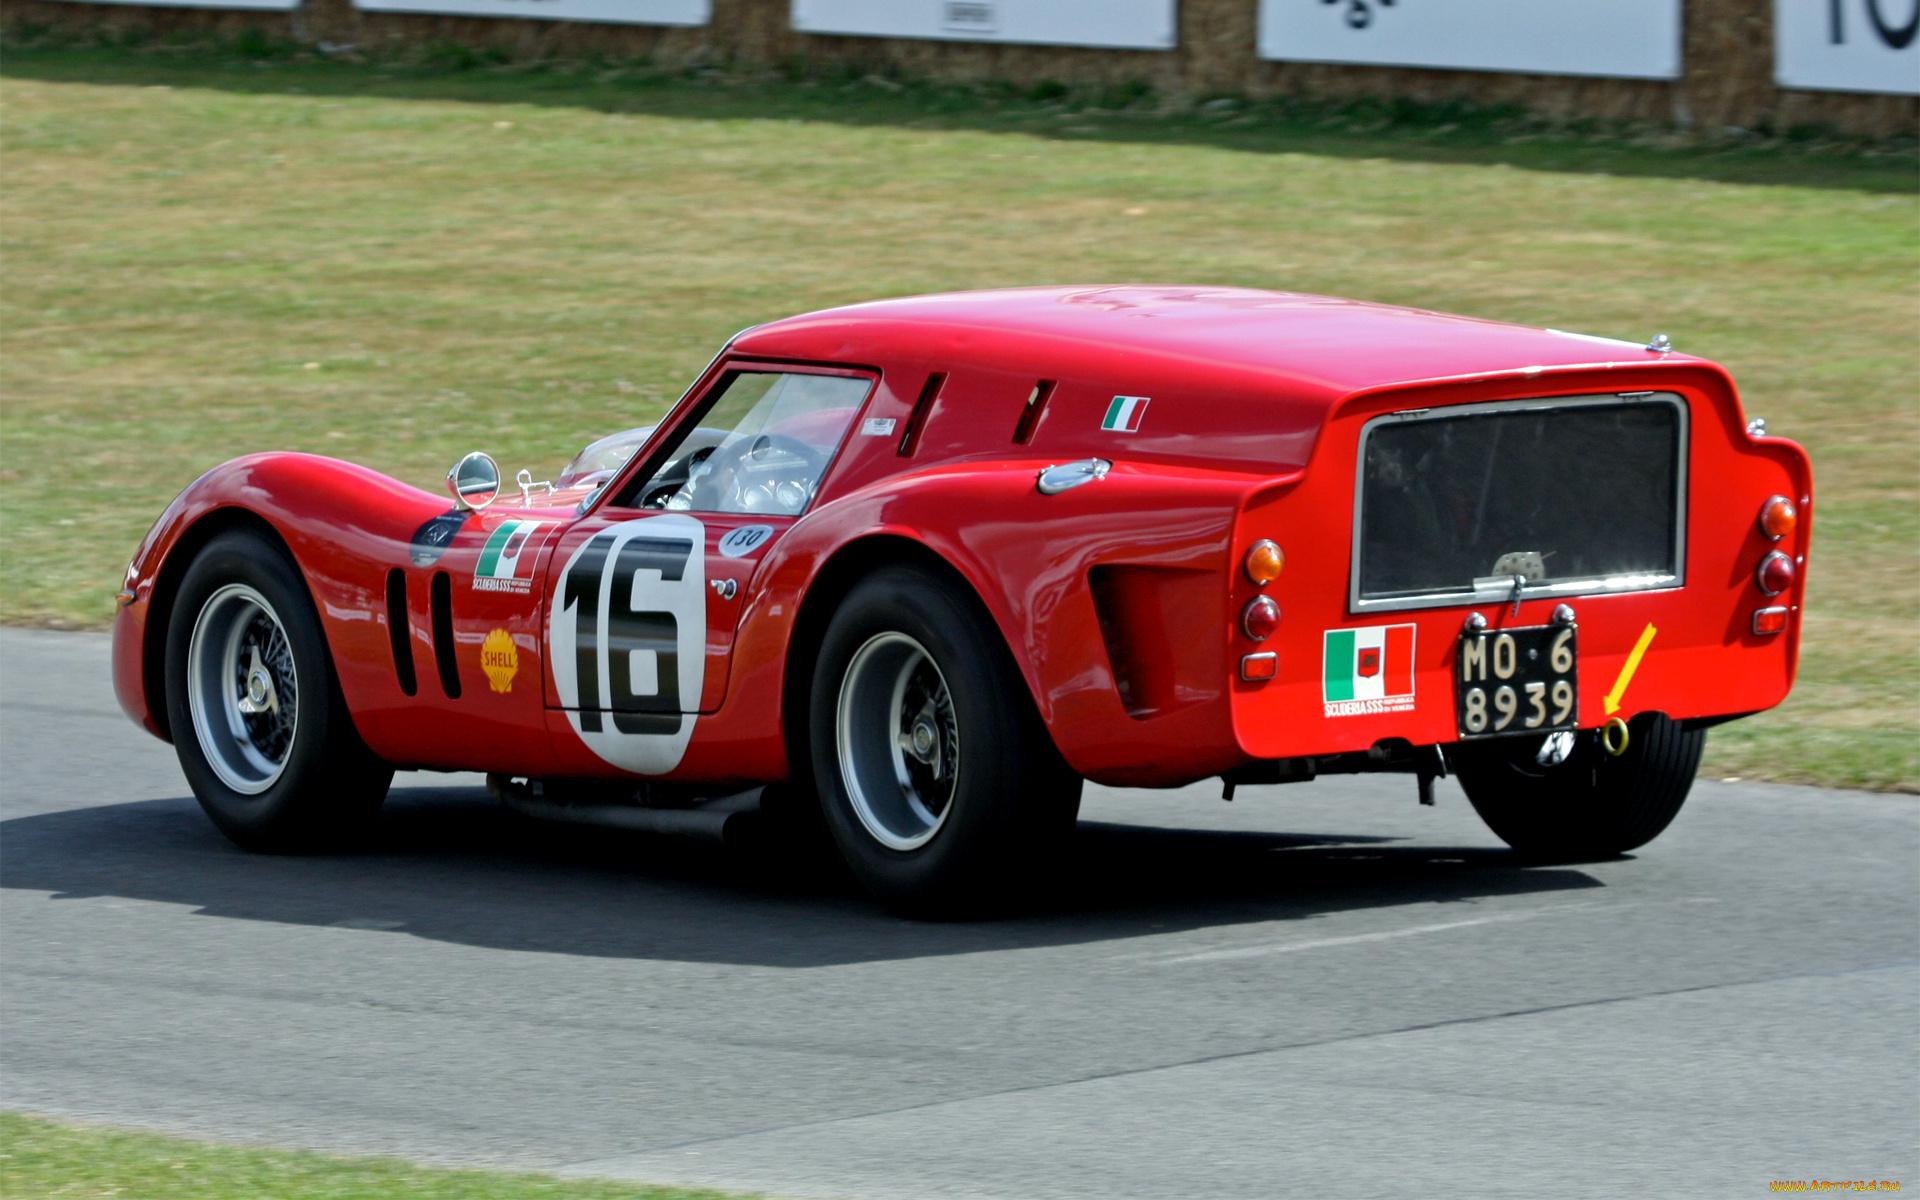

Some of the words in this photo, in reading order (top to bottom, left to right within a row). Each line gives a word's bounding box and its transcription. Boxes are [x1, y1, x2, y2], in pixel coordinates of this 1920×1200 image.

[726, 529, 764, 546] 130
[563, 535, 694, 735] 16
[485, 651, 514, 668] SHELL
[1464, 634, 1516, 682] MO
[1551, 628, 1573, 674] 6
[1324, 702, 1366, 718] SCUDERIA
[1366, 700, 1384, 714] SSS
[1466, 680, 1574, 733] 8939
